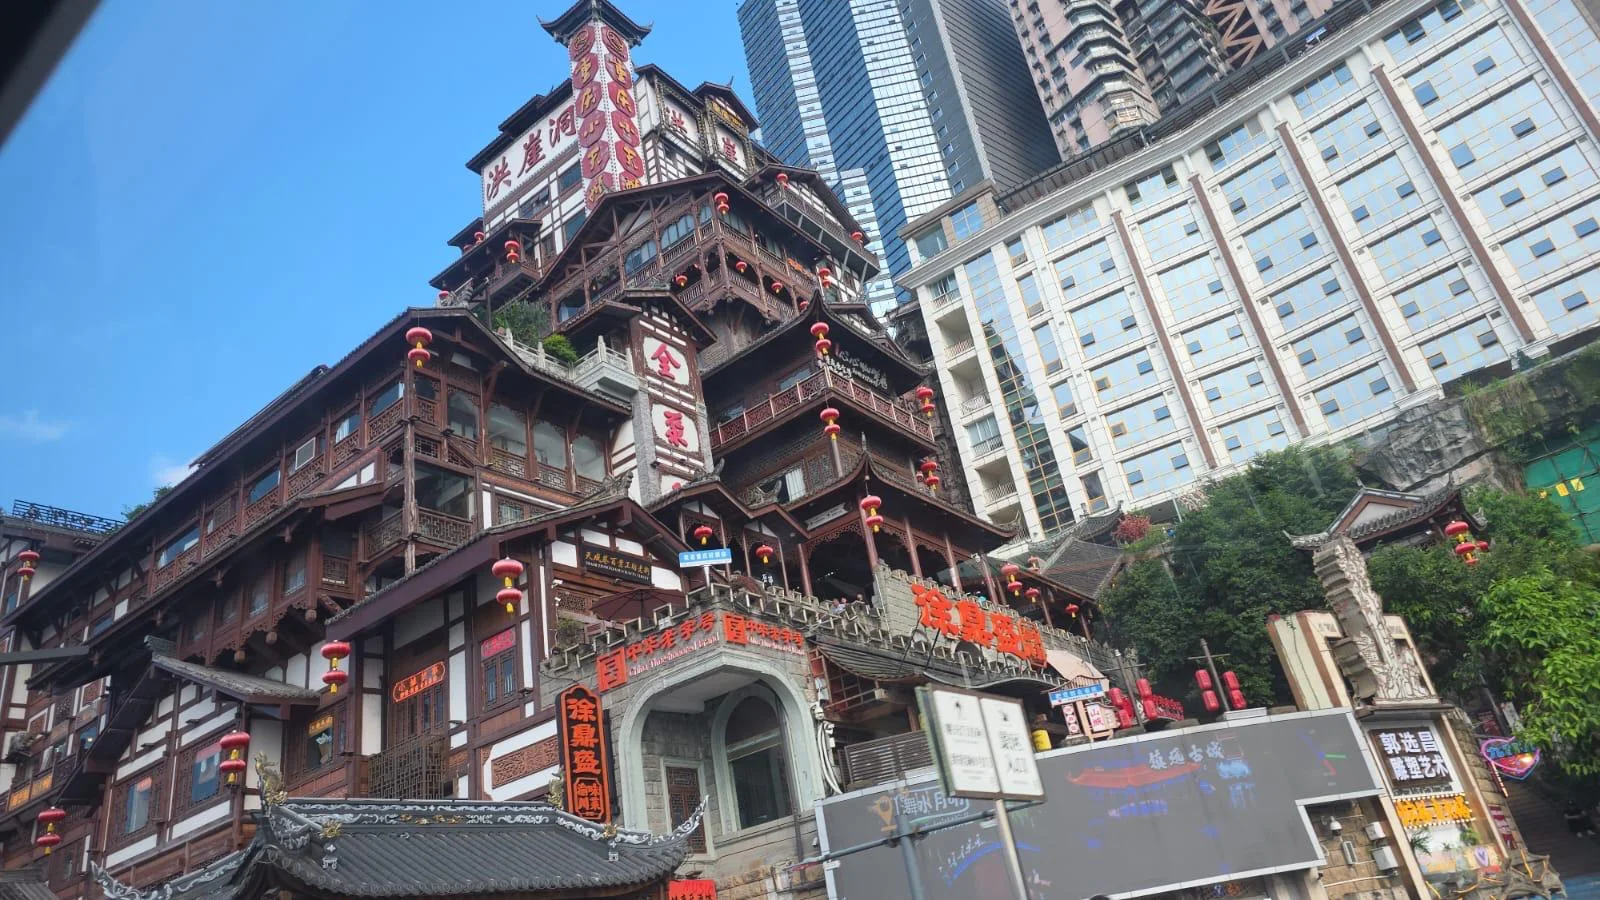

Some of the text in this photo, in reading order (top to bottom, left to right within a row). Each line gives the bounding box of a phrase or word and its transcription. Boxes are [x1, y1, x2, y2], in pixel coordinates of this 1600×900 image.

[486, 104, 577, 201] 洪崖洞
[626, 611, 716, 663] 中华老字号
[567, 697, 601, 775] 涂鼎盛
[1379, 731, 1438, 754] 郭选昌
[1389, 754, 1449, 781] 雕塑艺术
